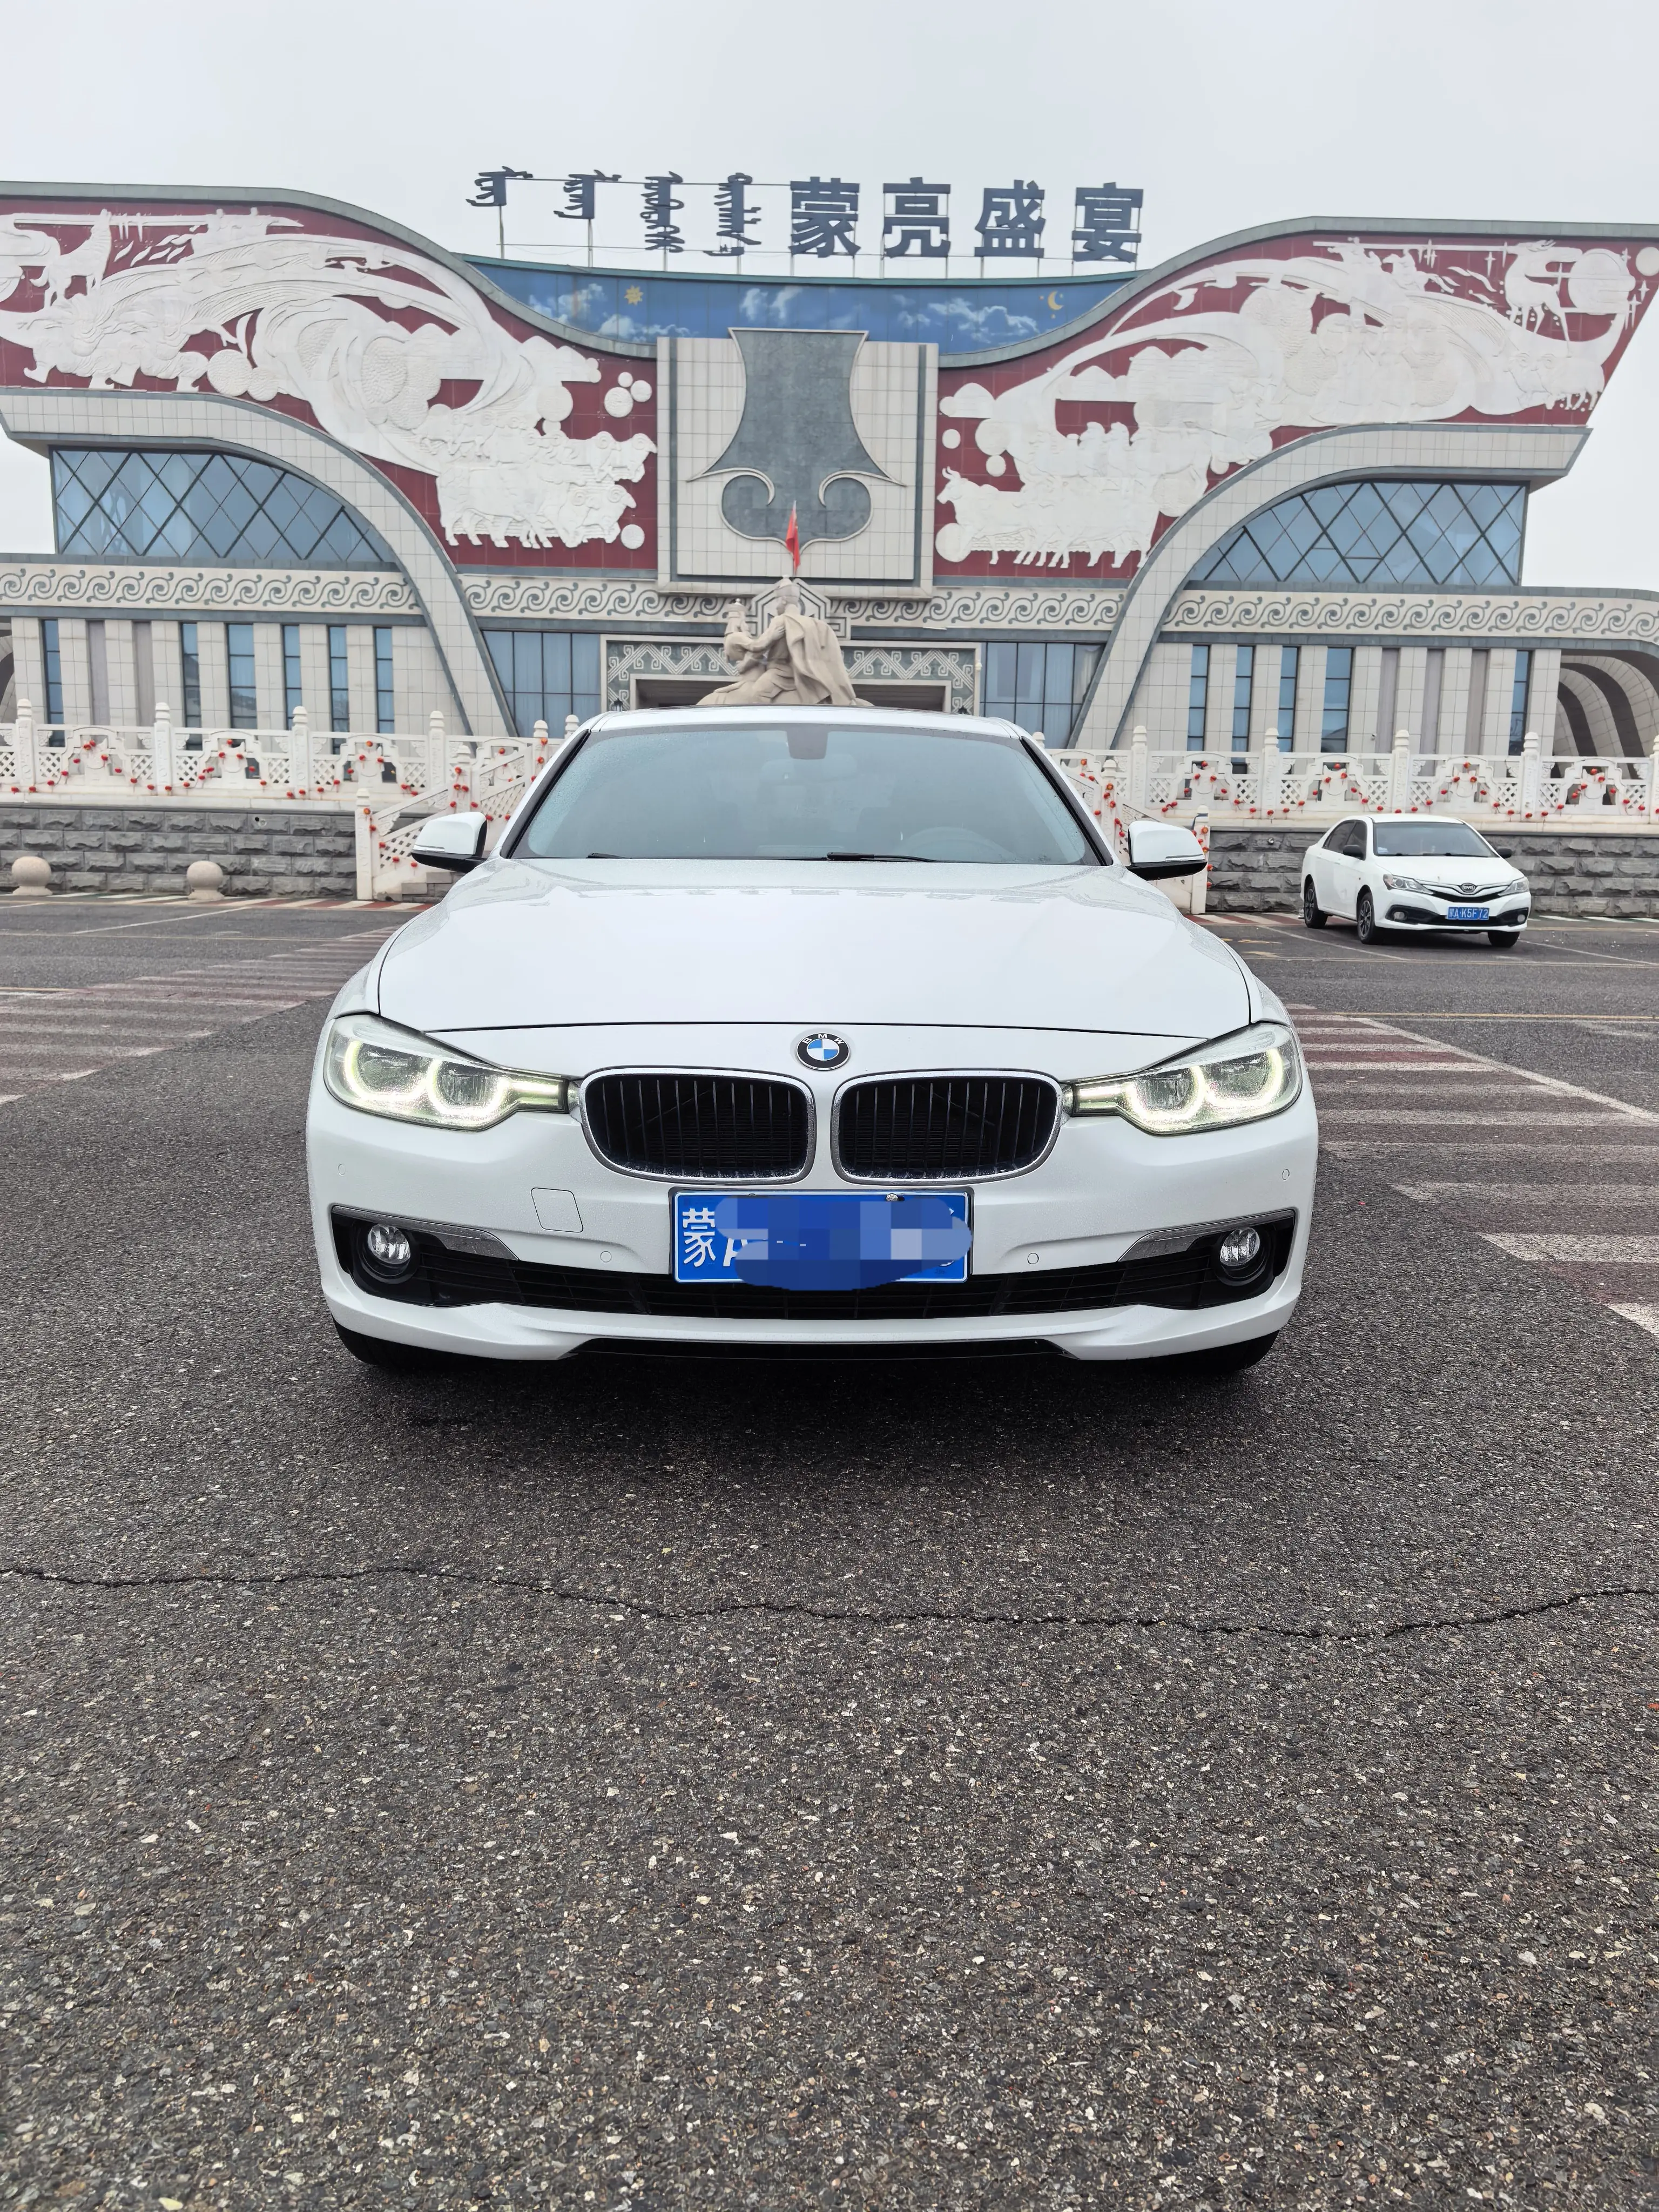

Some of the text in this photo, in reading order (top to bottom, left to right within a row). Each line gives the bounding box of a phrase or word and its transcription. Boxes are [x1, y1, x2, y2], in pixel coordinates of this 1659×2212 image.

[788, 176, 1144, 264] 蒙亮盛宴
[801, 1033, 845, 1044] BMW
